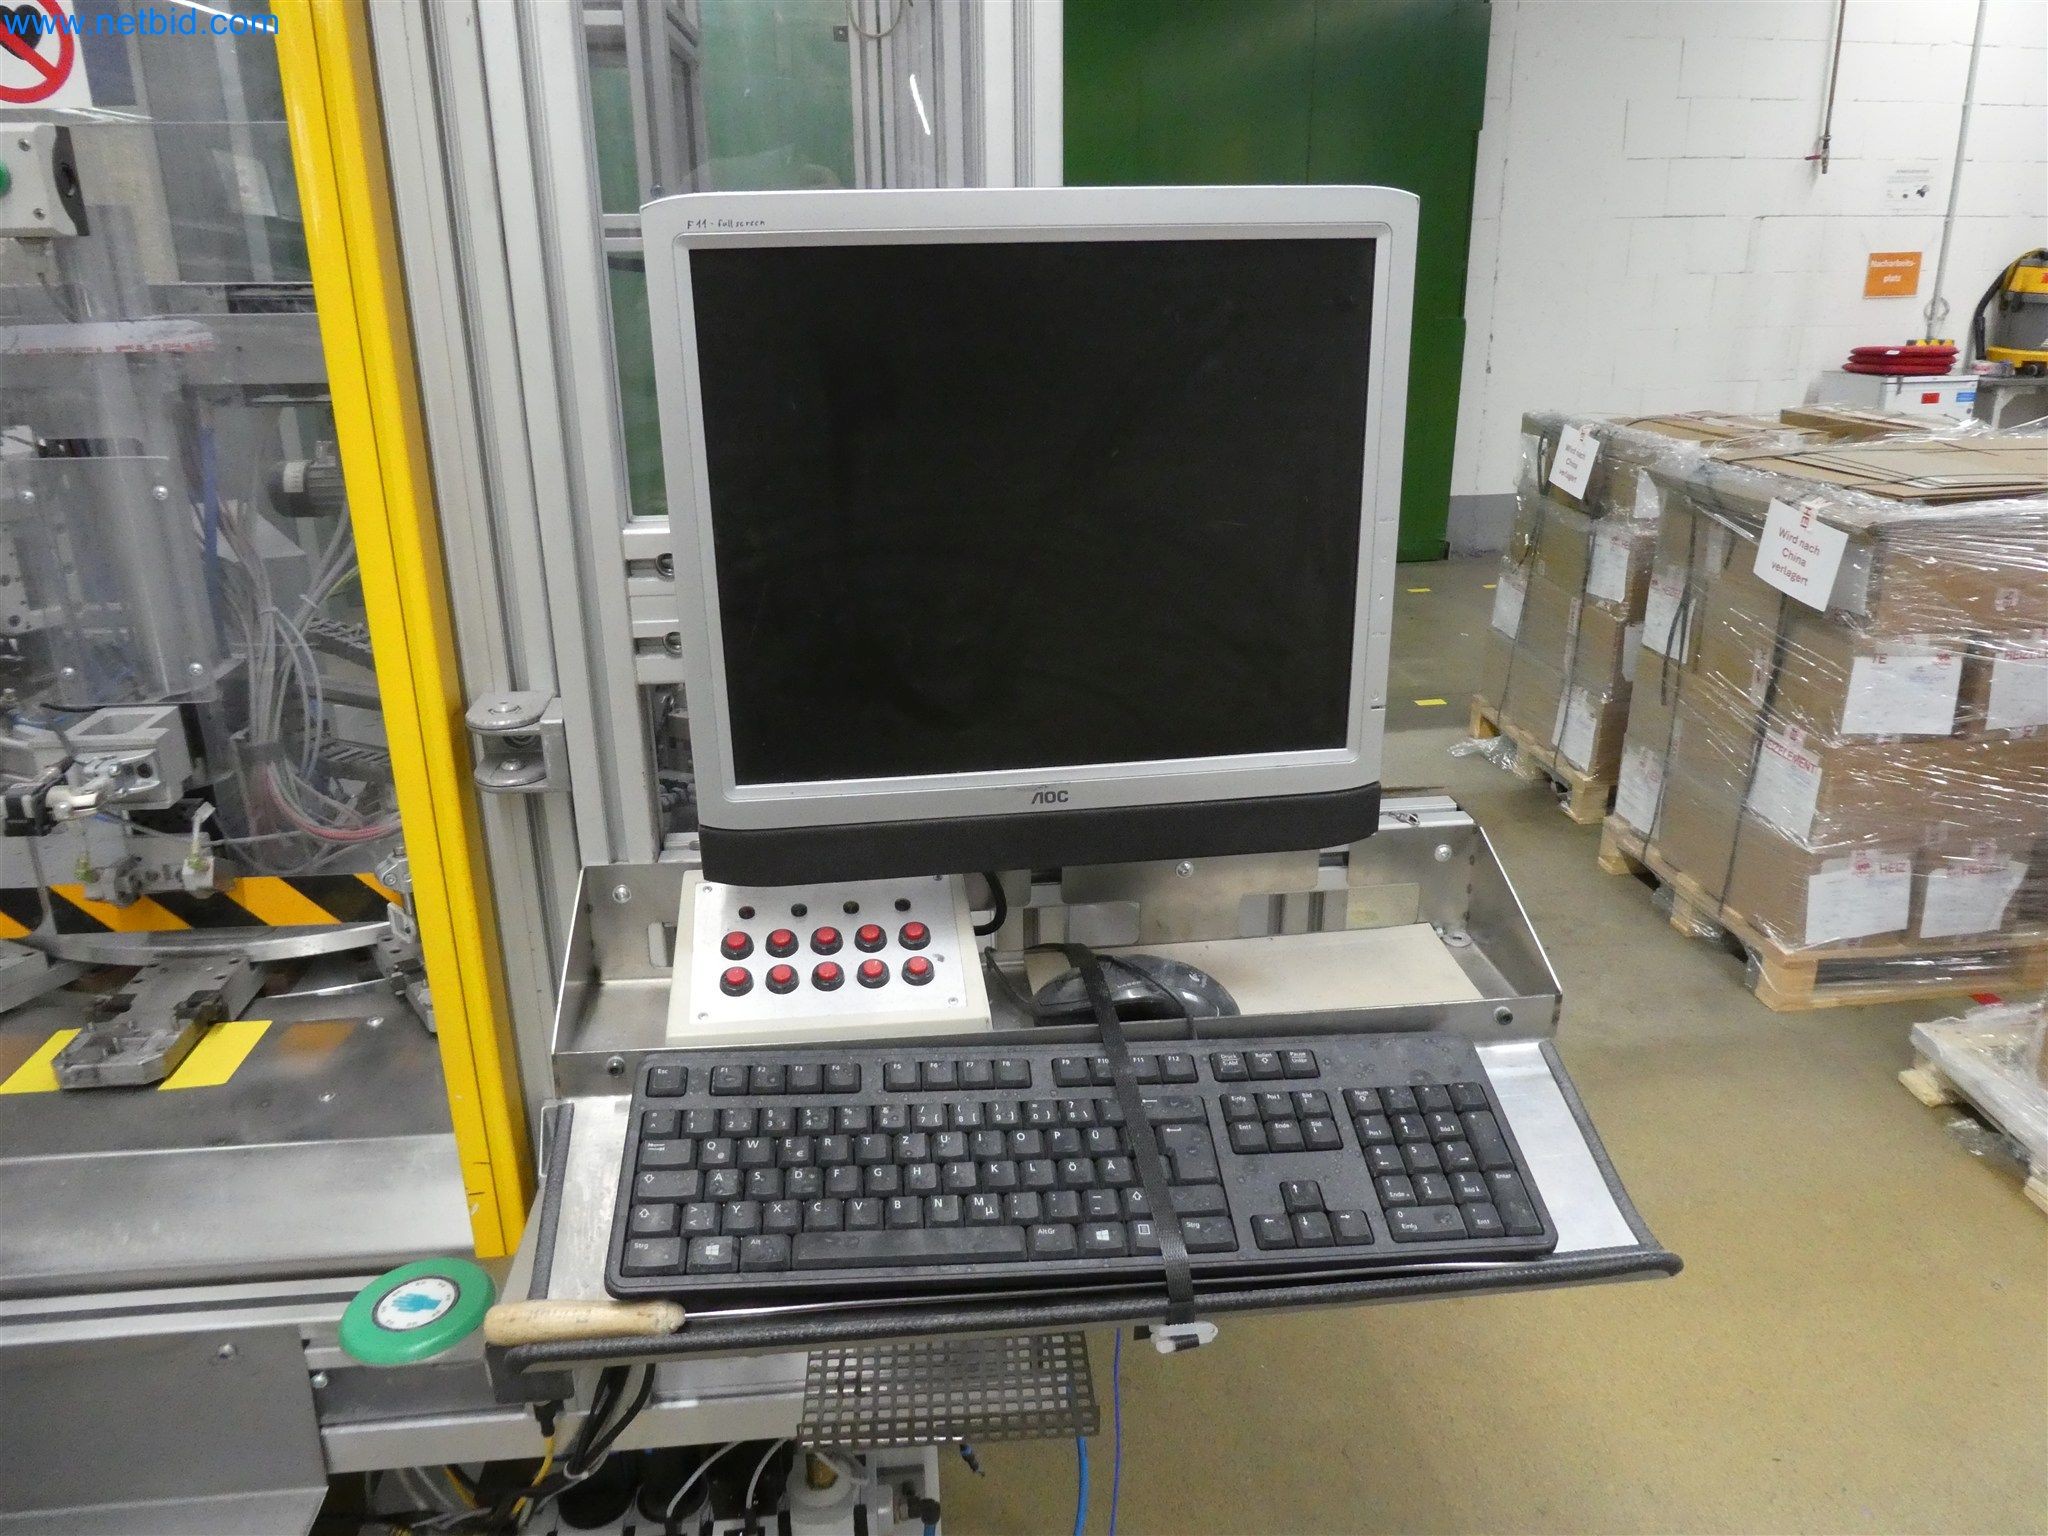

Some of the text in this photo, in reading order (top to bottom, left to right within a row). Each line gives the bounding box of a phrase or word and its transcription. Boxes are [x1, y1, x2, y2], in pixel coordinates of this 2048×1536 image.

[1778, 527, 1820, 556] Wird nach
[1782, 548, 1807, 567] China
[1771, 561, 1808, 586] verlagert
[1031, 790, 1068, 804] AOC
[707, 1141, 716, 1151] Q
[747, 1140, 760, 1149] W
[785, 1139, 792, 1148] E
[824, 1138, 832, 1146] R
[864, 1136, 871, 1145] T
[902, 1136, 909, 1144] Z
[940, 1134, 948, 1143] U
[1016, 1133, 1026, 1142] O
[1054, 1132, 1061, 1140] P
[714, 1172, 723, 1182] A
[754, 1172, 761, 1180] S
[794, 1170, 803, 1179] D
[834, 1169, 840, 1178] F
[874, 1168, 882, 1177] G
[913, 1166, 922, 1175] H
[991, 1164, 999, 1173] K
[1030, 1163, 1036, 1172] L
[1068, 1162, 1077, 1172] Ö
[1107, 1160, 1116, 1170] Ä
[732, 1205, 741, 1214] Y
[773, 1204, 782, 1213] X
[813, 1202, 821, 1212] C
[854, 1202, 863, 1210] V
[894, 1200, 901, 1209] B
[934, 1198, 943, 1208] N
[974, 1197, 984, 1206] M
[985, 1206, 994, 1216] µ
